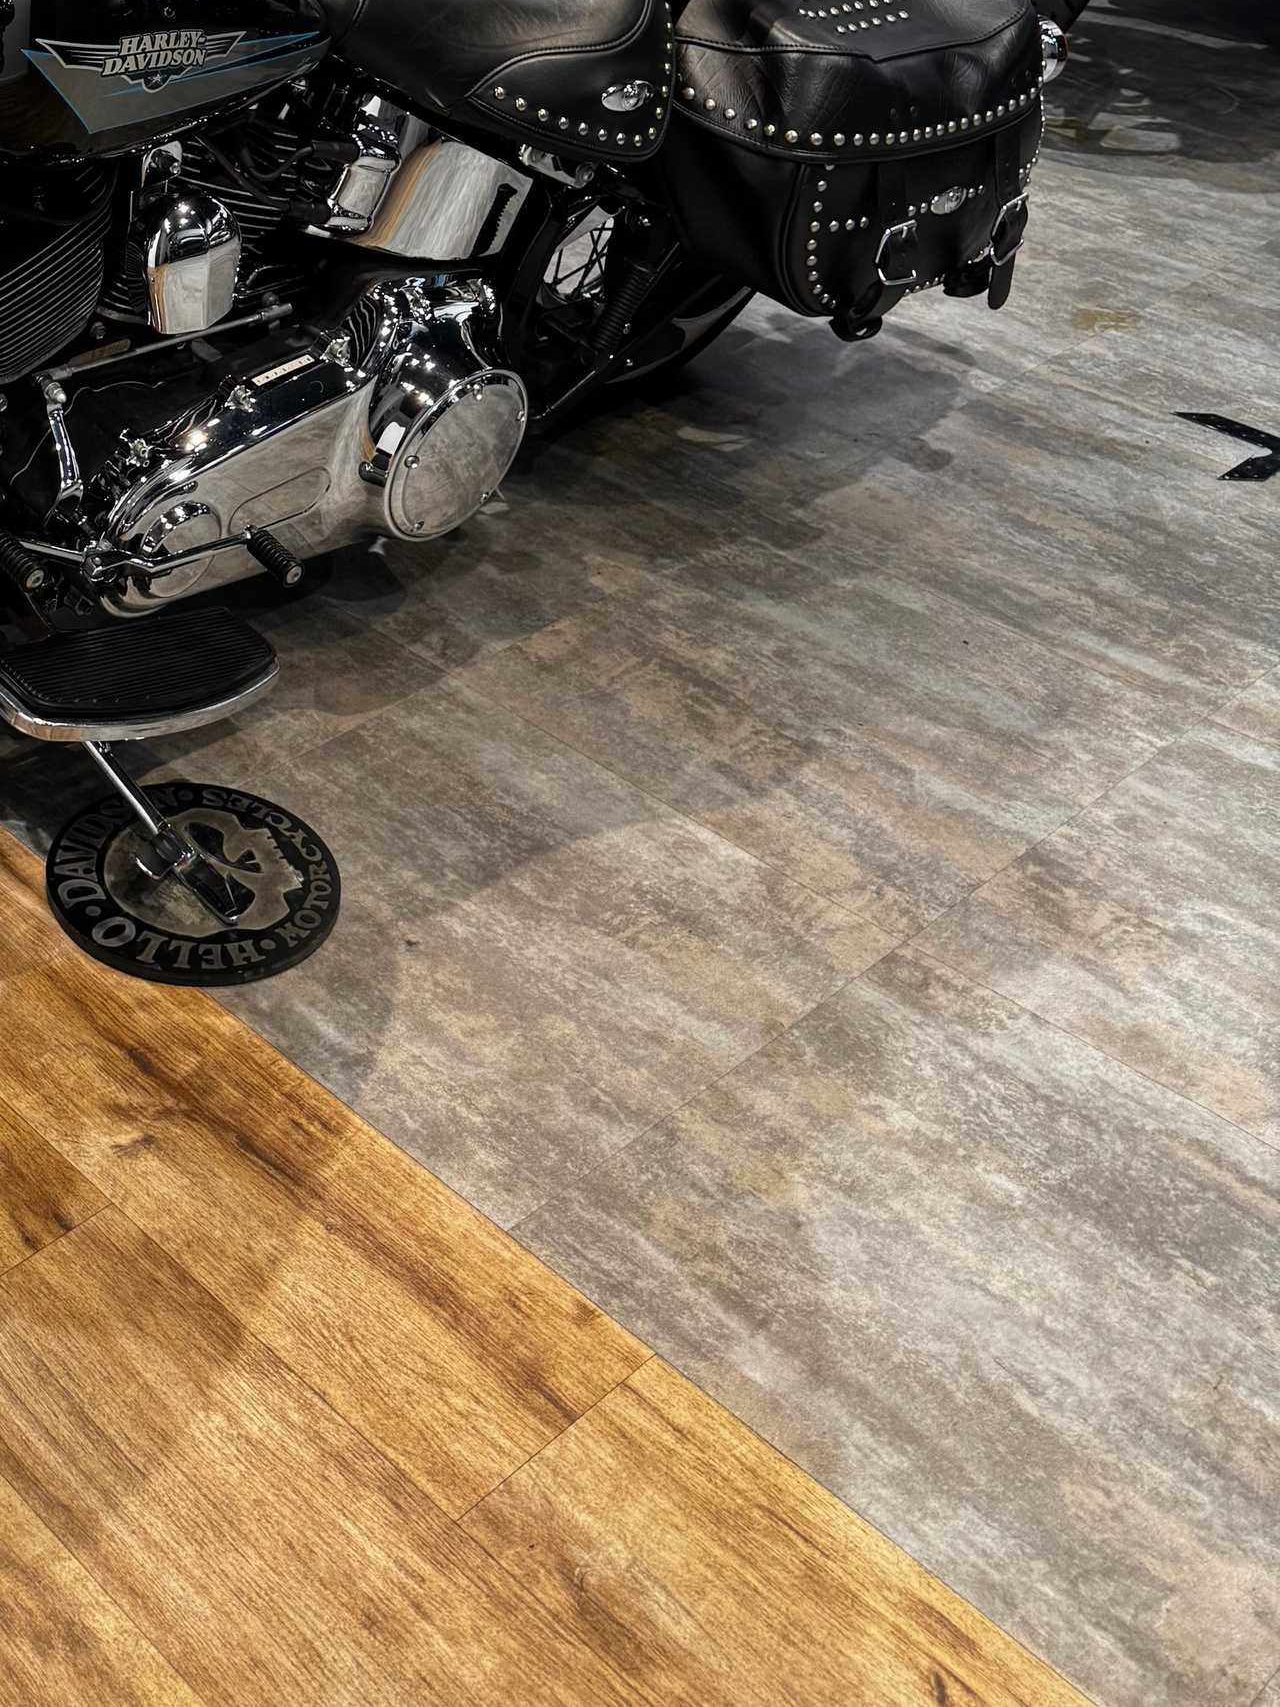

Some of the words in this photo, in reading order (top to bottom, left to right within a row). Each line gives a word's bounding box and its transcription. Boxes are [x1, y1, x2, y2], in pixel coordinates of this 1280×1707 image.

[102, 49, 206, 76] DAVIDSON
[120, 30, 206, 56] HARLEY-
[54, 787, 178, 909] DAVIDSN
[92, 915, 266, 970] HELLO
